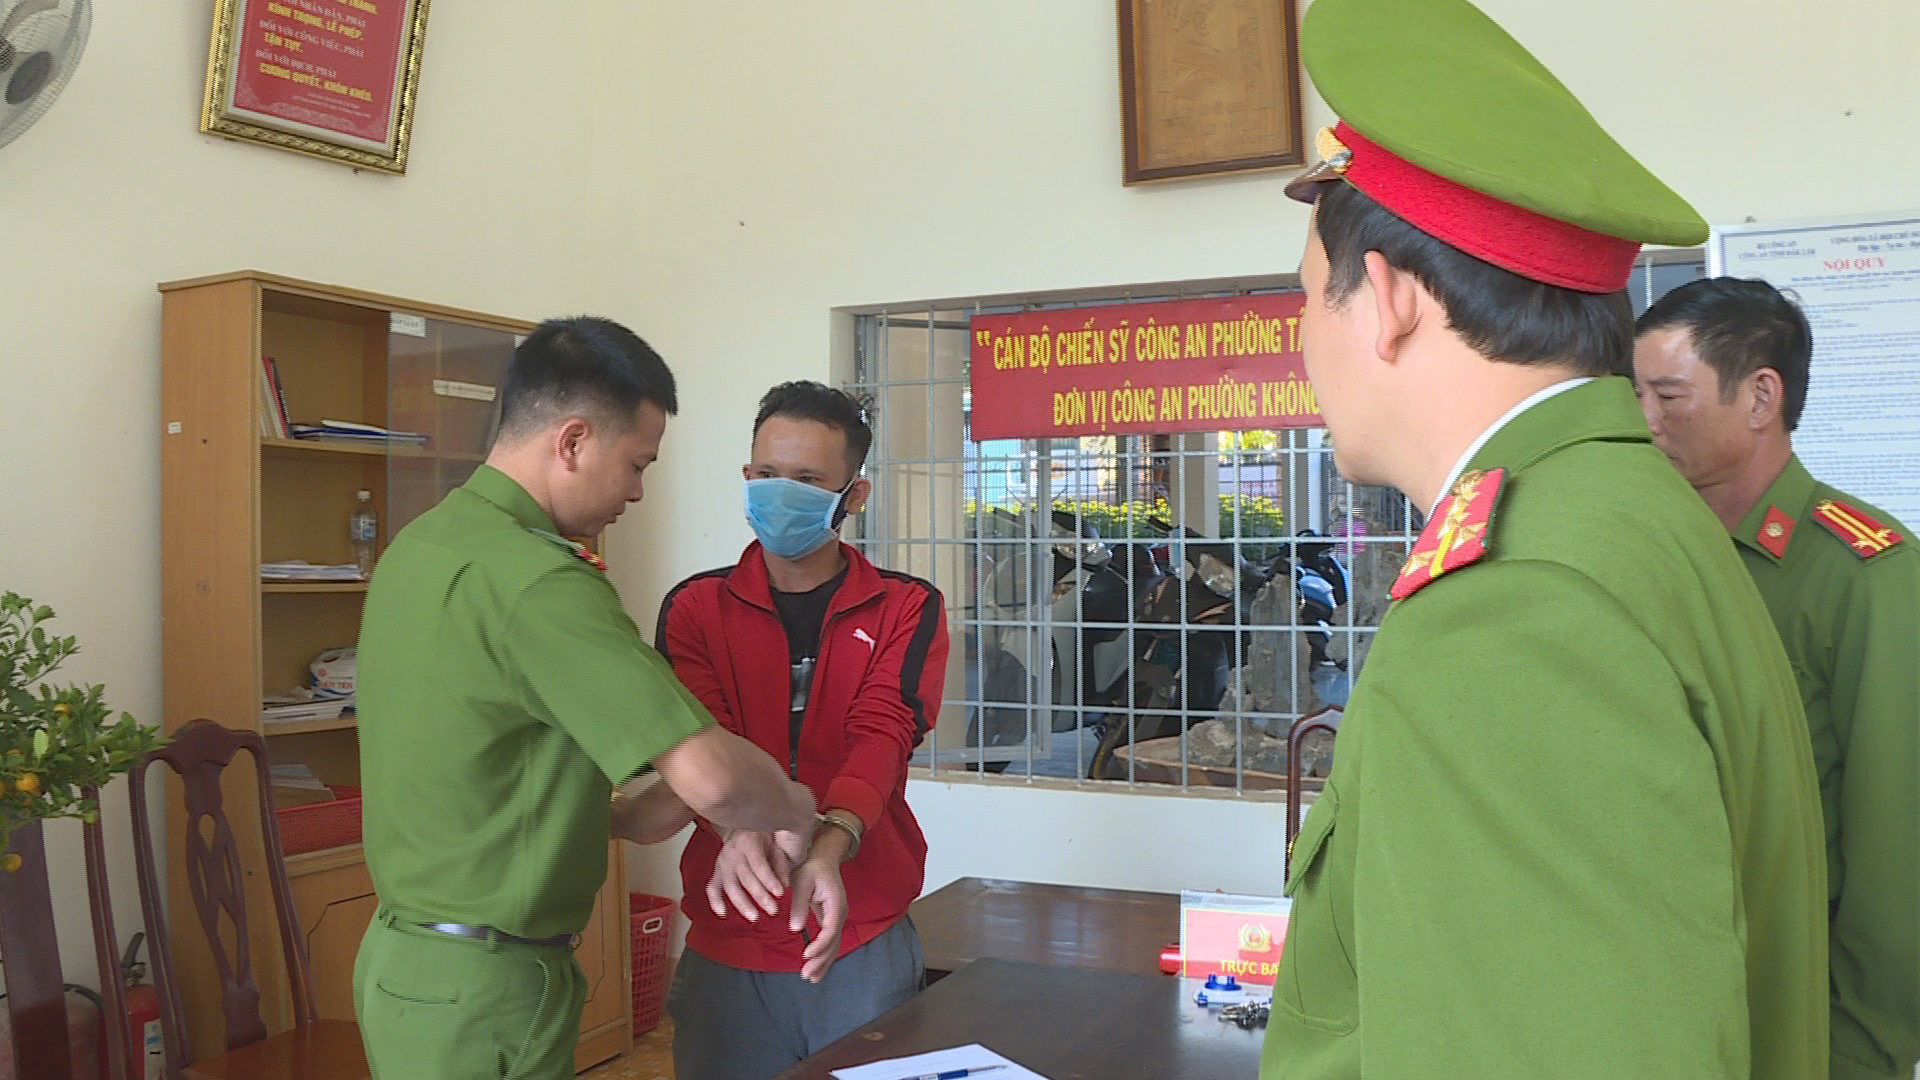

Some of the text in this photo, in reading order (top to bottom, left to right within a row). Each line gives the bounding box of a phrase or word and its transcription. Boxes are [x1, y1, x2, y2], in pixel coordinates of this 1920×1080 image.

[268, 2, 292, 17] KÍNH
[1824, 256, 1886, 272] NỘI QUY
[1029, 324, 1051, 375] BỘ
[1056, 316, 1104, 367] CHIẾN
[1109, 319, 1130, 364] SỸ
[1135, 316, 1181, 361] CÔNG
[1184, 322, 1207, 359] AN
[1212, 310, 1282, 357] PHƯỜNG
[1053, 386, 1086, 427] ĐƠN
[1091, 389, 1107, 431] VỊ
[1111, 378, 1156, 424] CÔNG
[1159, 386, 1183, 422] AN
[1188, 374, 1257, 420] PHƯỜNG
[1219, 959, 1258, 977] TRỰC
